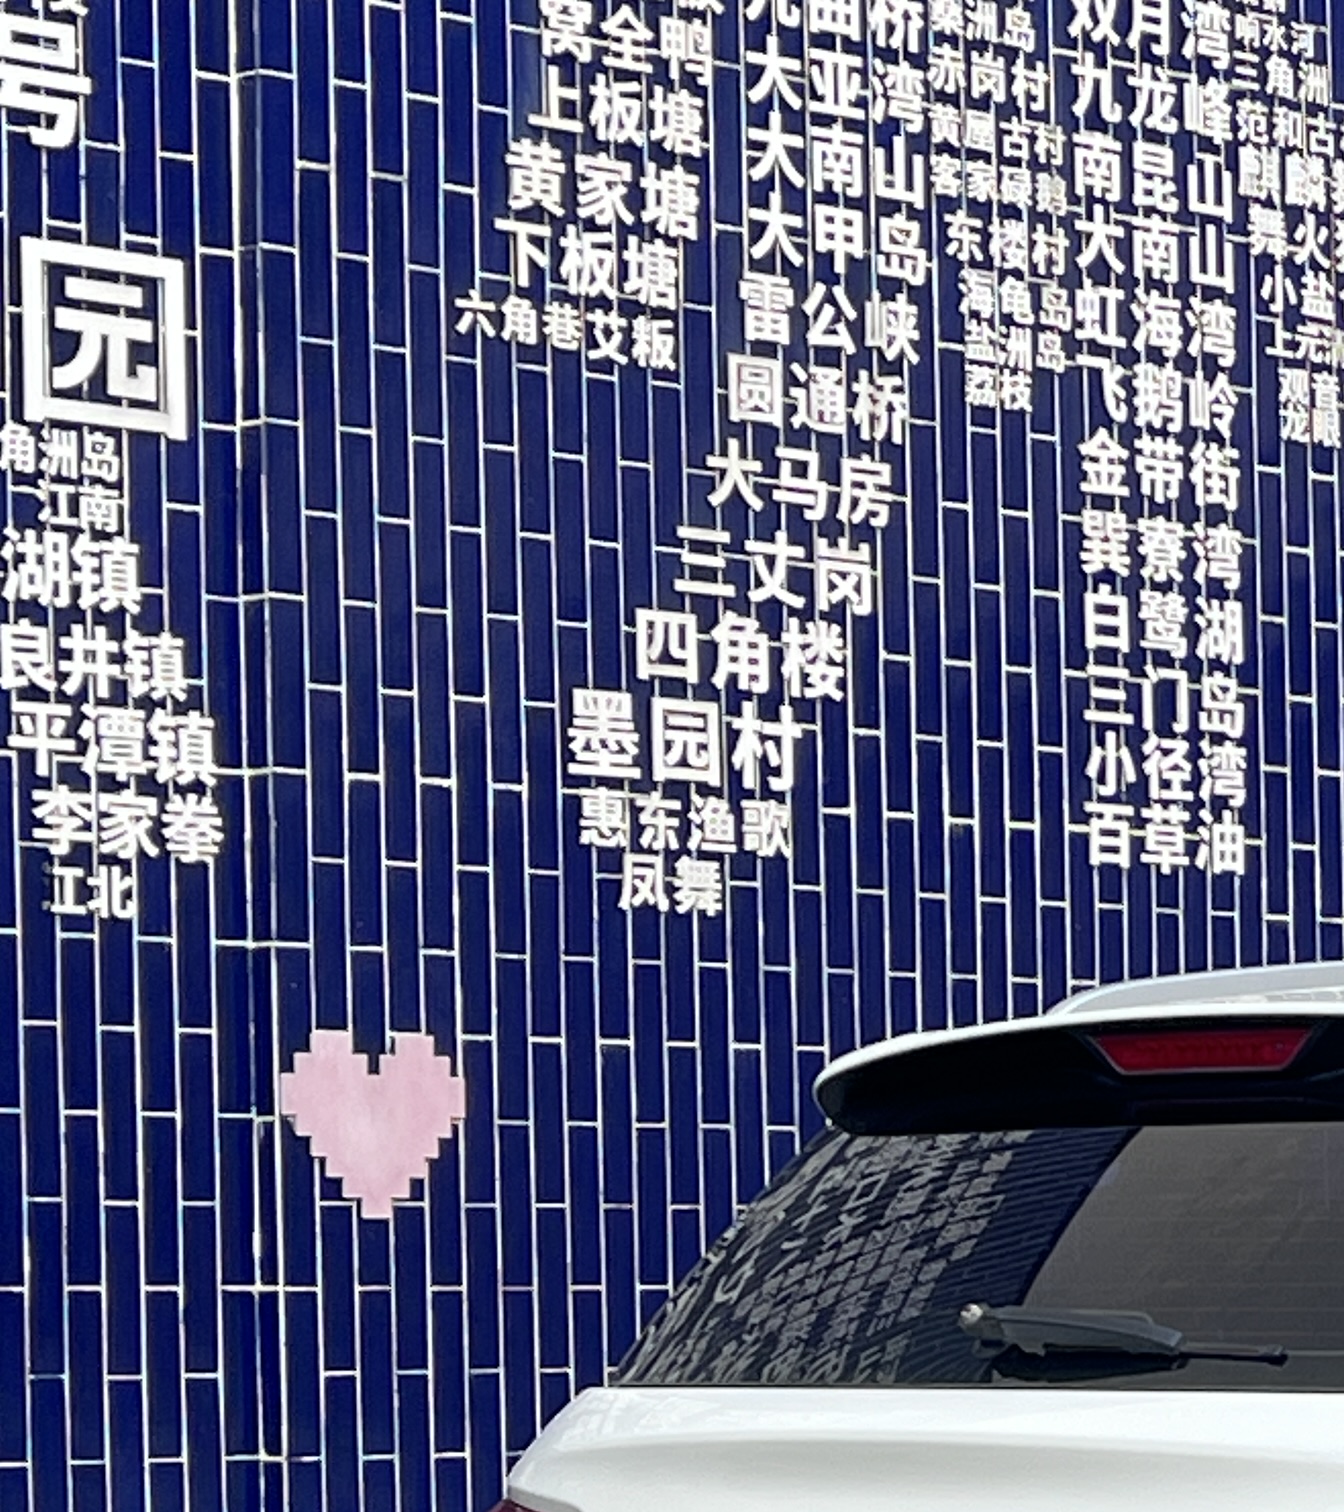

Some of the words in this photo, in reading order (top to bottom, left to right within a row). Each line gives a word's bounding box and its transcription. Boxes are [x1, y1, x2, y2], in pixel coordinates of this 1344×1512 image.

[927, 42, 1050, 111] 赤岗村
[1235, 11, 1315, 58] 响水河
[527, 64, 703, 157] 上板塘
[745, 34, 925, 134] 大亚湾
[1071, 52, 1233, 145] 九龙峰
[1231, 50, 1329, 106] 三角洲
[506, 137, 699, 241] 黄家塘
[747, 110, 925, 210] 大南山
[1072, 128, 1233, 223] 南昆山
[494, 217, 678, 311] 下板塘
[748, 190, 927, 286] 大甲岛
[944, 210, 1070, 275] 东楼村
[1074, 203, 1234, 294] 大南山
[20, 236, 188, 441] 园
[740, 271, 920, 366] 雷公峡
[959, 267, 1072, 332] 海龟岛
[1074, 279, 1236, 367] 虹海湾
[965, 320, 1066, 374] 盐洲岛
[727, 352, 907, 445] 圆通桥
[1075, 353, 1238, 439] 飞鹅岭
[38, 479, 120, 532] 江南
[706, 438, 891, 528] 大马房
[1077, 426, 1240, 511] 金带街
[1, 527, 141, 614] 湖镇
[674, 526, 871, 616] 三丈岗
[1079, 508, 1243, 590] 巽寮湾
[0, 619, 187, 701] 良井镇
[635, 608, 844, 702] 四角楼
[1083, 582, 1244, 665] 白鹭湖
[7, 700, 216, 786] 平潭镇
[567, 688, 802, 791] 墨园村
[1083, 663, 1245, 738] 三门岛
[1085, 730, 1247, 807] 小径湾
[31, 784, 224, 863] 李家拳
[579, 787, 790, 858] 惠东渔歌
[1083, 801, 1245, 875] 百草油
